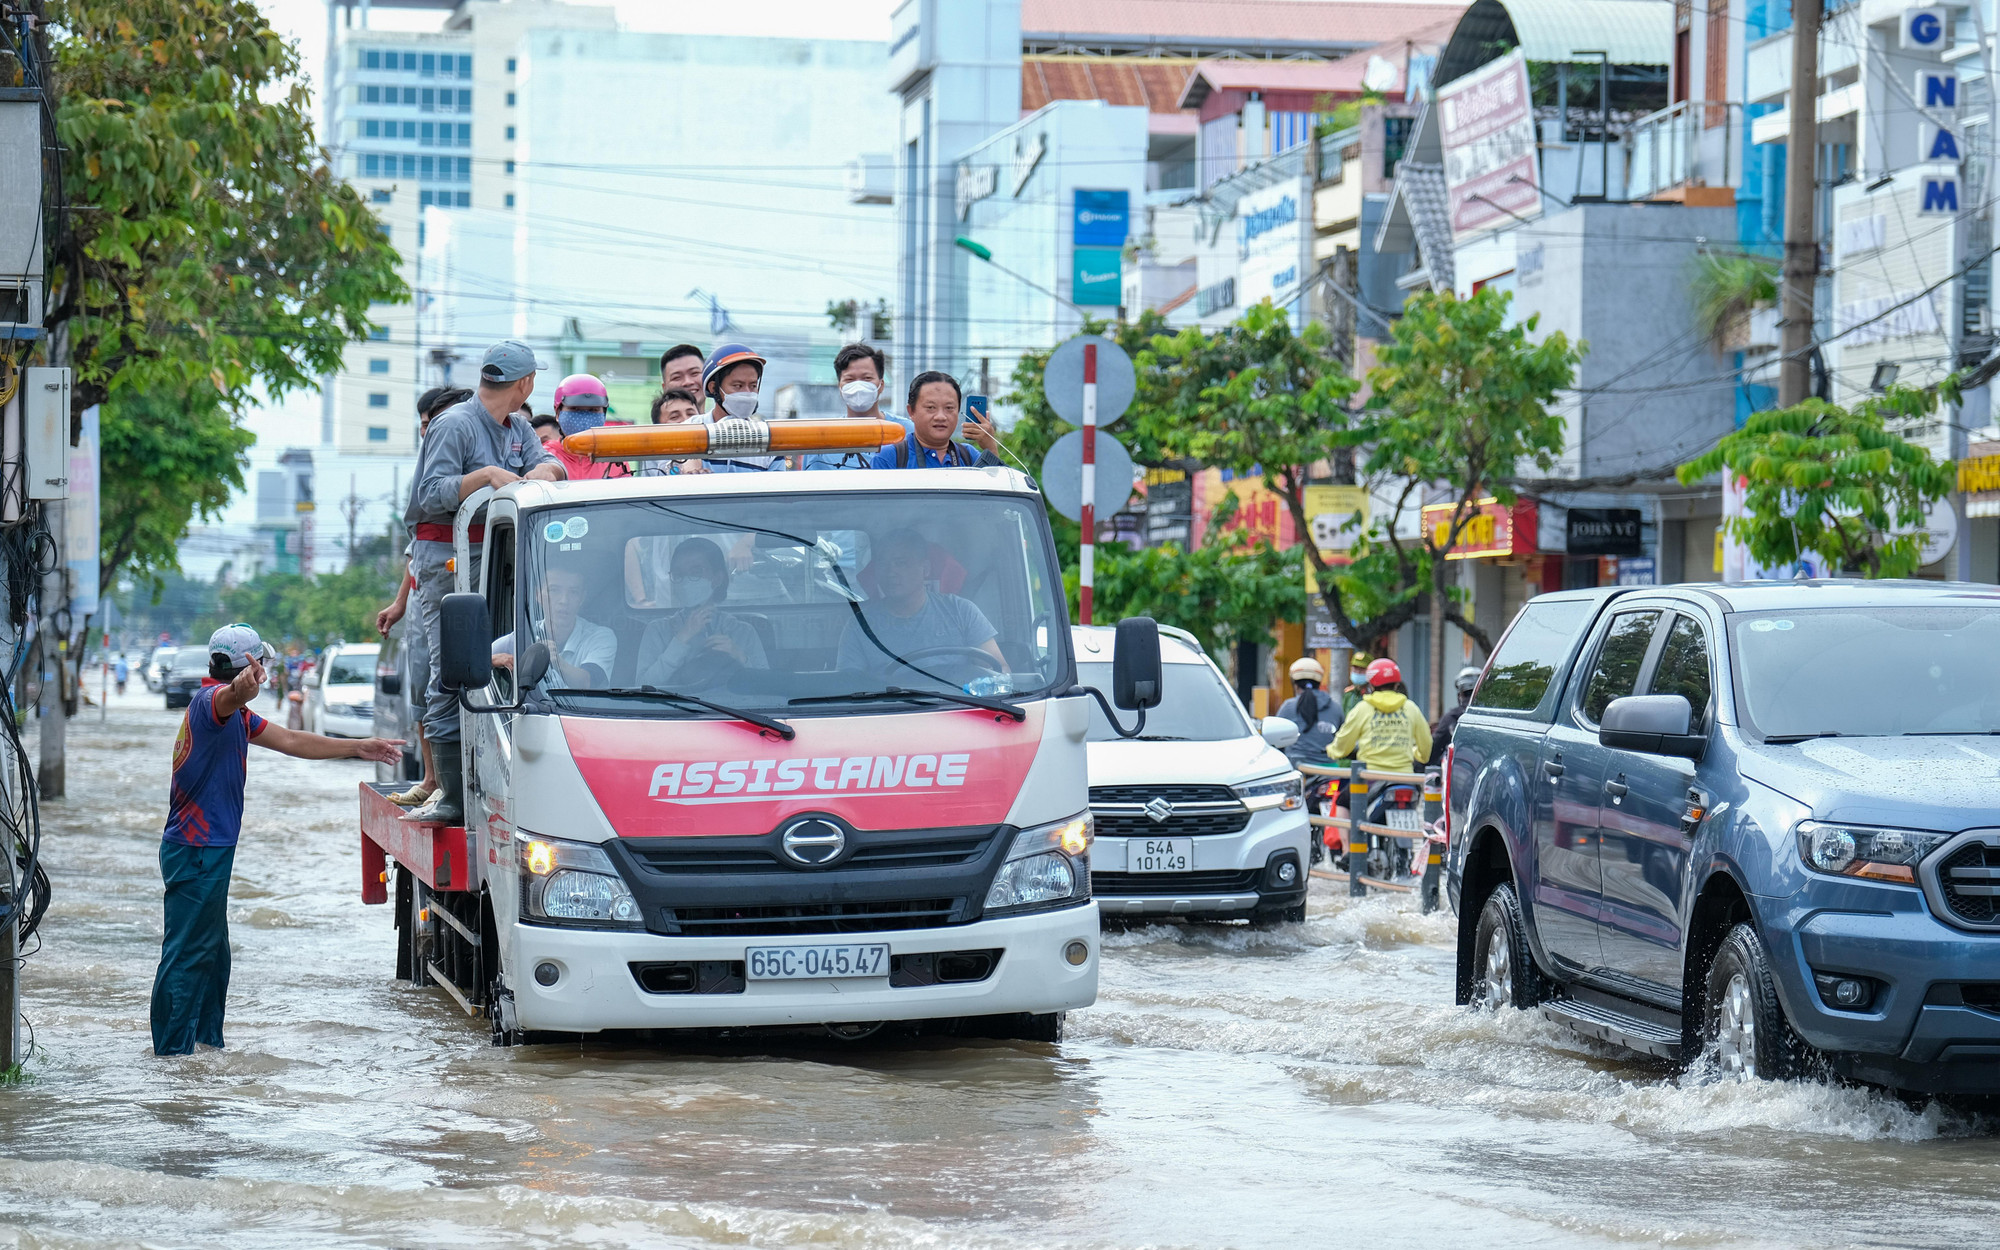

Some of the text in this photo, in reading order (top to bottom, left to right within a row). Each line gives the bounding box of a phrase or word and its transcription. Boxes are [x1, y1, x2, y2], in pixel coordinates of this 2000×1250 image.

[1571, 521, 1613, 538] JOHN
[647, 753, 971, 797] ASSISTANCE
[1146, 841, 1174, 855] 64A
[1136, 856, 1186, 870] 101.49
[751, 947, 884, 977] 65C-045.47
